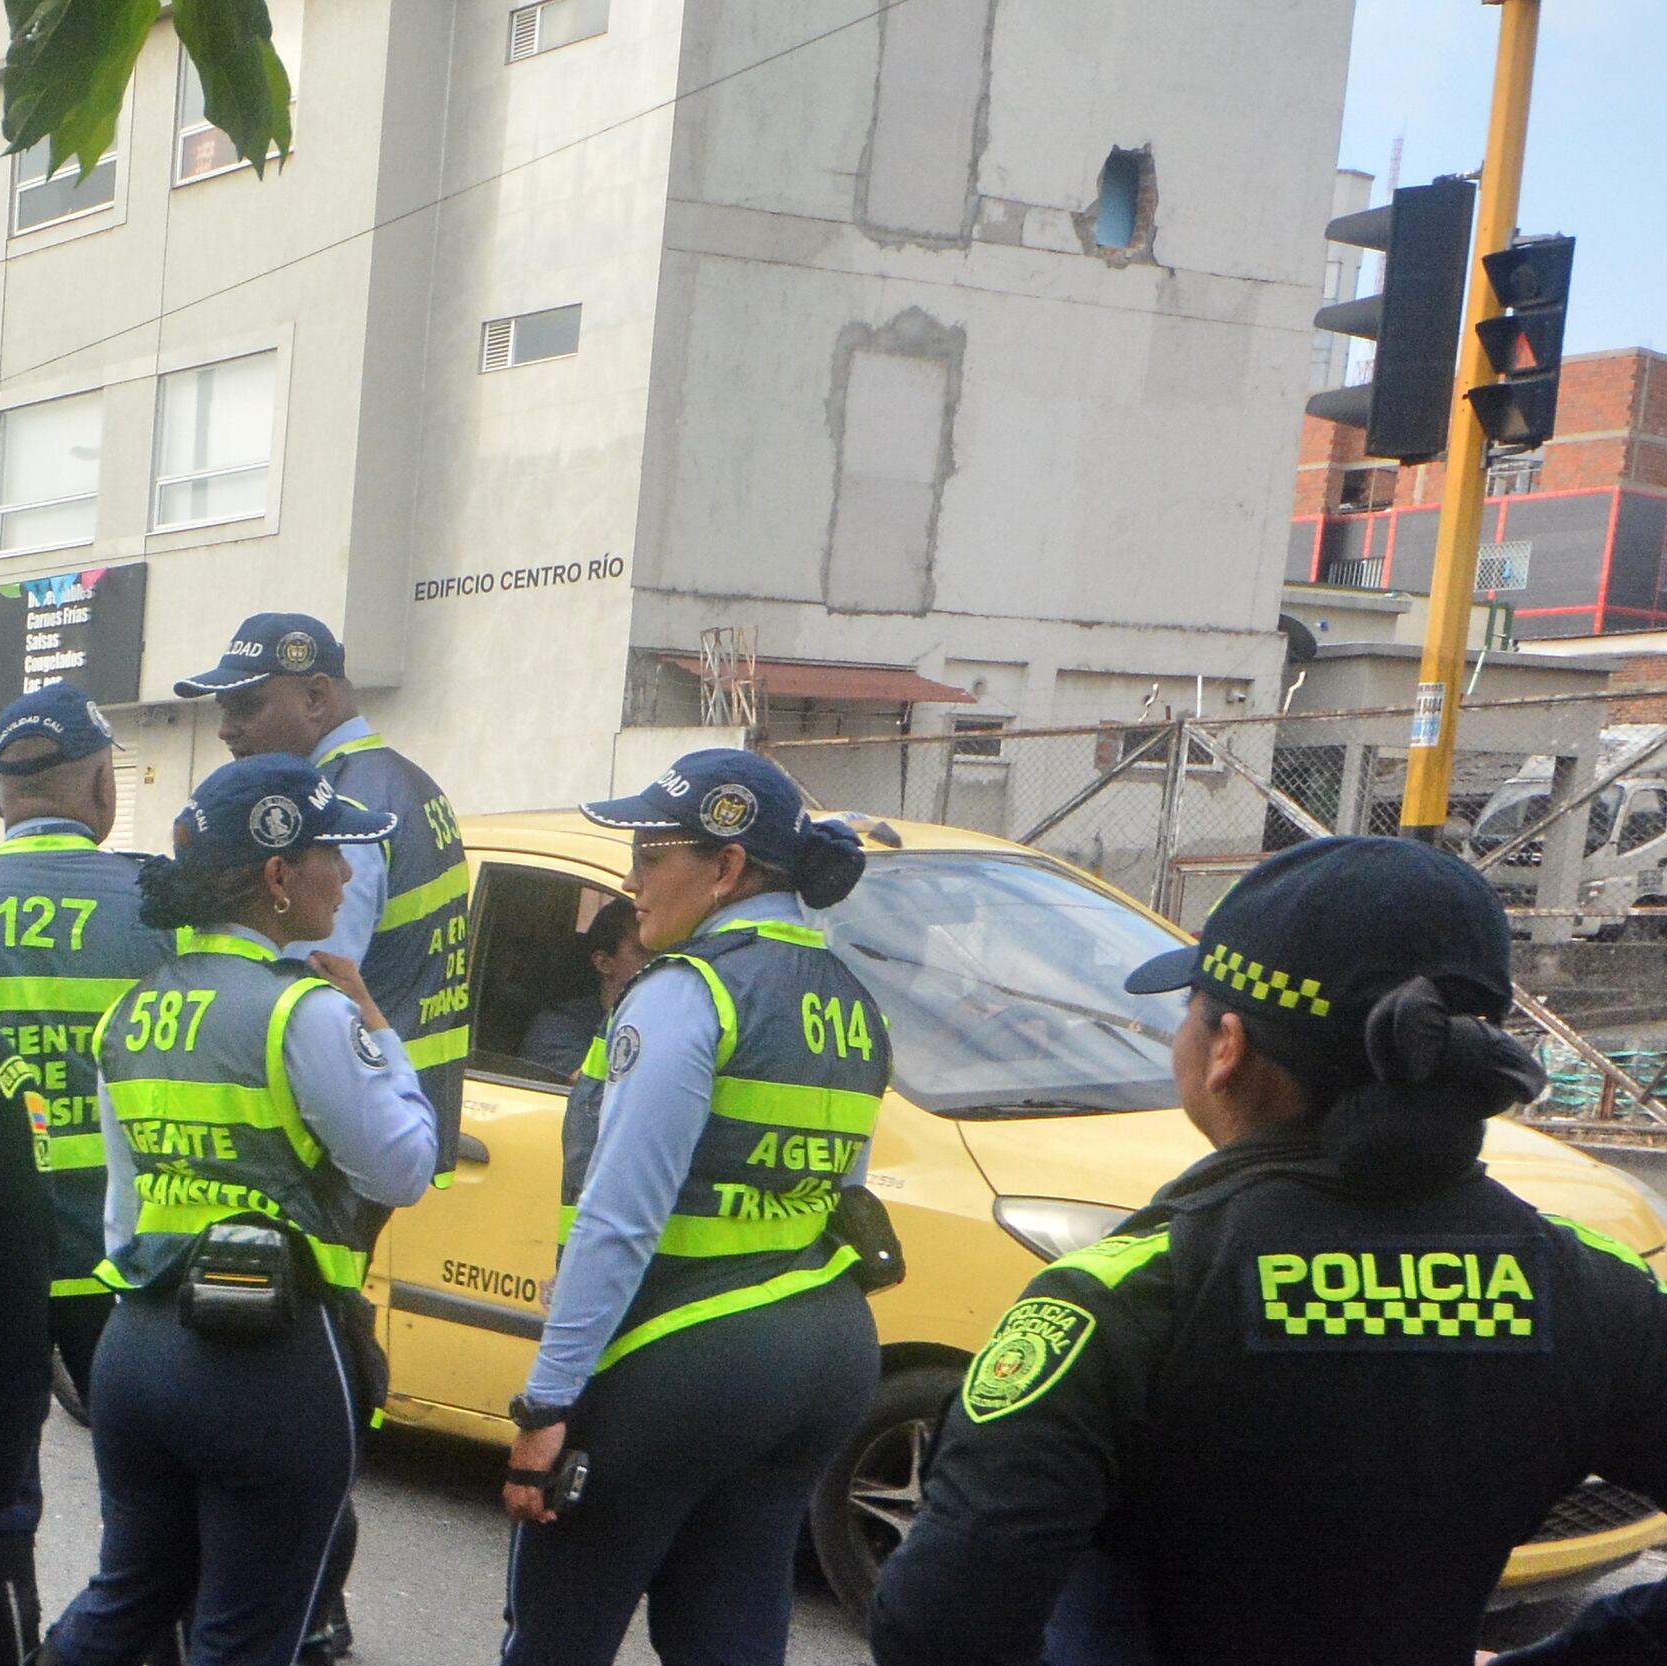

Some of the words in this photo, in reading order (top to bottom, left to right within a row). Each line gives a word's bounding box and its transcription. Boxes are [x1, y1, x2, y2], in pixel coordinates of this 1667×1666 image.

[415, 573, 495, 602] EDIFICIO
[500, 562, 582, 591] CENTRO
[587, 553, 624, 581] RÍO
[26, 632, 60, 652] Salsas
[27, 611, 63, 630] Carnes
[125, 989, 218, 1053] 587
[801, 992, 873, 1062] 614
[442, 1259, 537, 1303] SERVICIO
[1257, 1252, 1534, 1301] POLICIA
